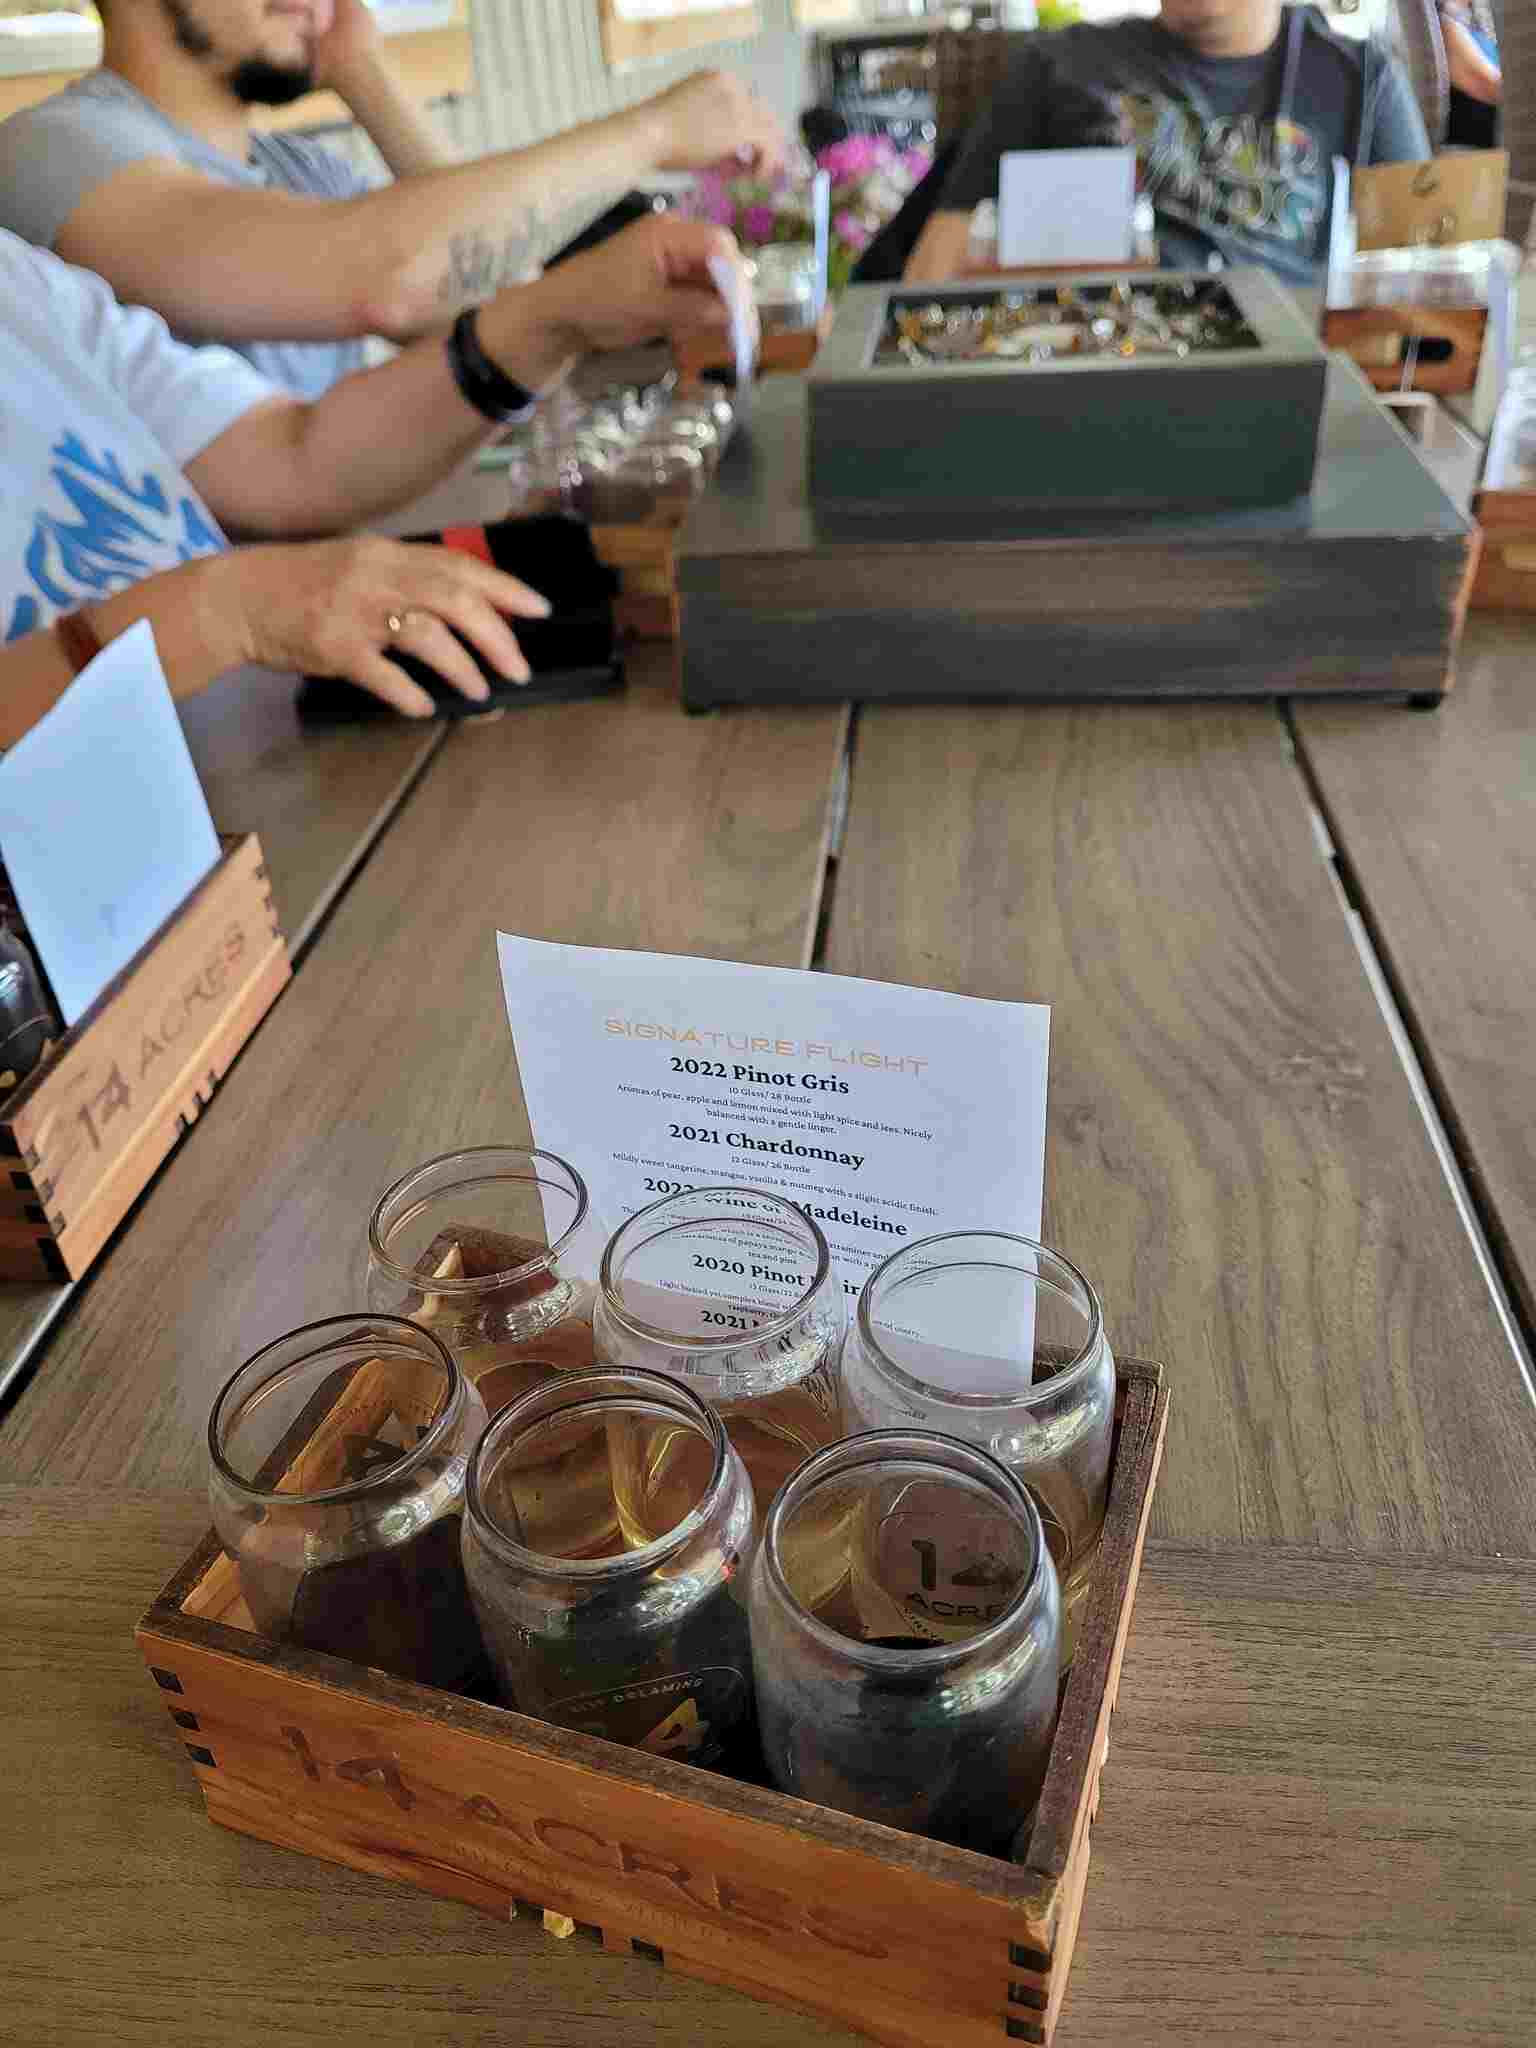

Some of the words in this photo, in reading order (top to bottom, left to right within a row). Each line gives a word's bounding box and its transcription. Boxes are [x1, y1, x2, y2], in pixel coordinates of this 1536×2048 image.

[77, 1060, 131, 1149] 14
[139, 921, 244, 1080] ACRES
[604, 1017, 795, 1056] SIGNATURE
[805, 1040, 929, 1078] FLIGHT
[670, 1057, 727, 1078] 2022
[733, 1064, 796, 1087] Pinot
[801, 1073, 849, 1094] Gris
[617, 1083, 650, 1096] Aromas
[651, 1088, 660, 1097] of
[686, 1094, 710, 1105] apple
[711, 1097, 728, 1106] and
[730, 1100, 758, 1112] lemon
[760, 1105, 788, 1116] mixed
[790, 1108, 812, 1119] with
[814, 1110, 834, 1123] light
[837, 1115, 860, 1127] spice
[861, 1119, 879, 1130] and
[903, 1126, 933, 1142] Nicely
[706, 1108, 747, 1122] balanced
[749, 1114, 768, 1125] with
[778, 1117, 806, 1130] gentle
[784, 1093, 812, 1104] Bottle
[669, 1124, 720, 1144] 2021
[726, 1132, 864, 1170] Chardonnay
[613, 1152, 638, 1165] Mildly
[641, 1157, 664, 1168] sweet
[749, 1174, 778, 1185] vanilla
[790, 1181, 825, 1195] nutmeg
[825, 1185, 846, 1197] with
[855, 1191, 879, 1204] slight
[882, 1197, 908, 1210] acidic
[692, 1254, 744, 1275] 2020
[751, 1264, 807, 1287] Pinot
[701, 1310, 748, 1330] 2021
[906, 1592, 1010, 1619] ACRE
[281, 1725, 417, 1811] 14
[463, 1794, 889, 1958] ACRES
